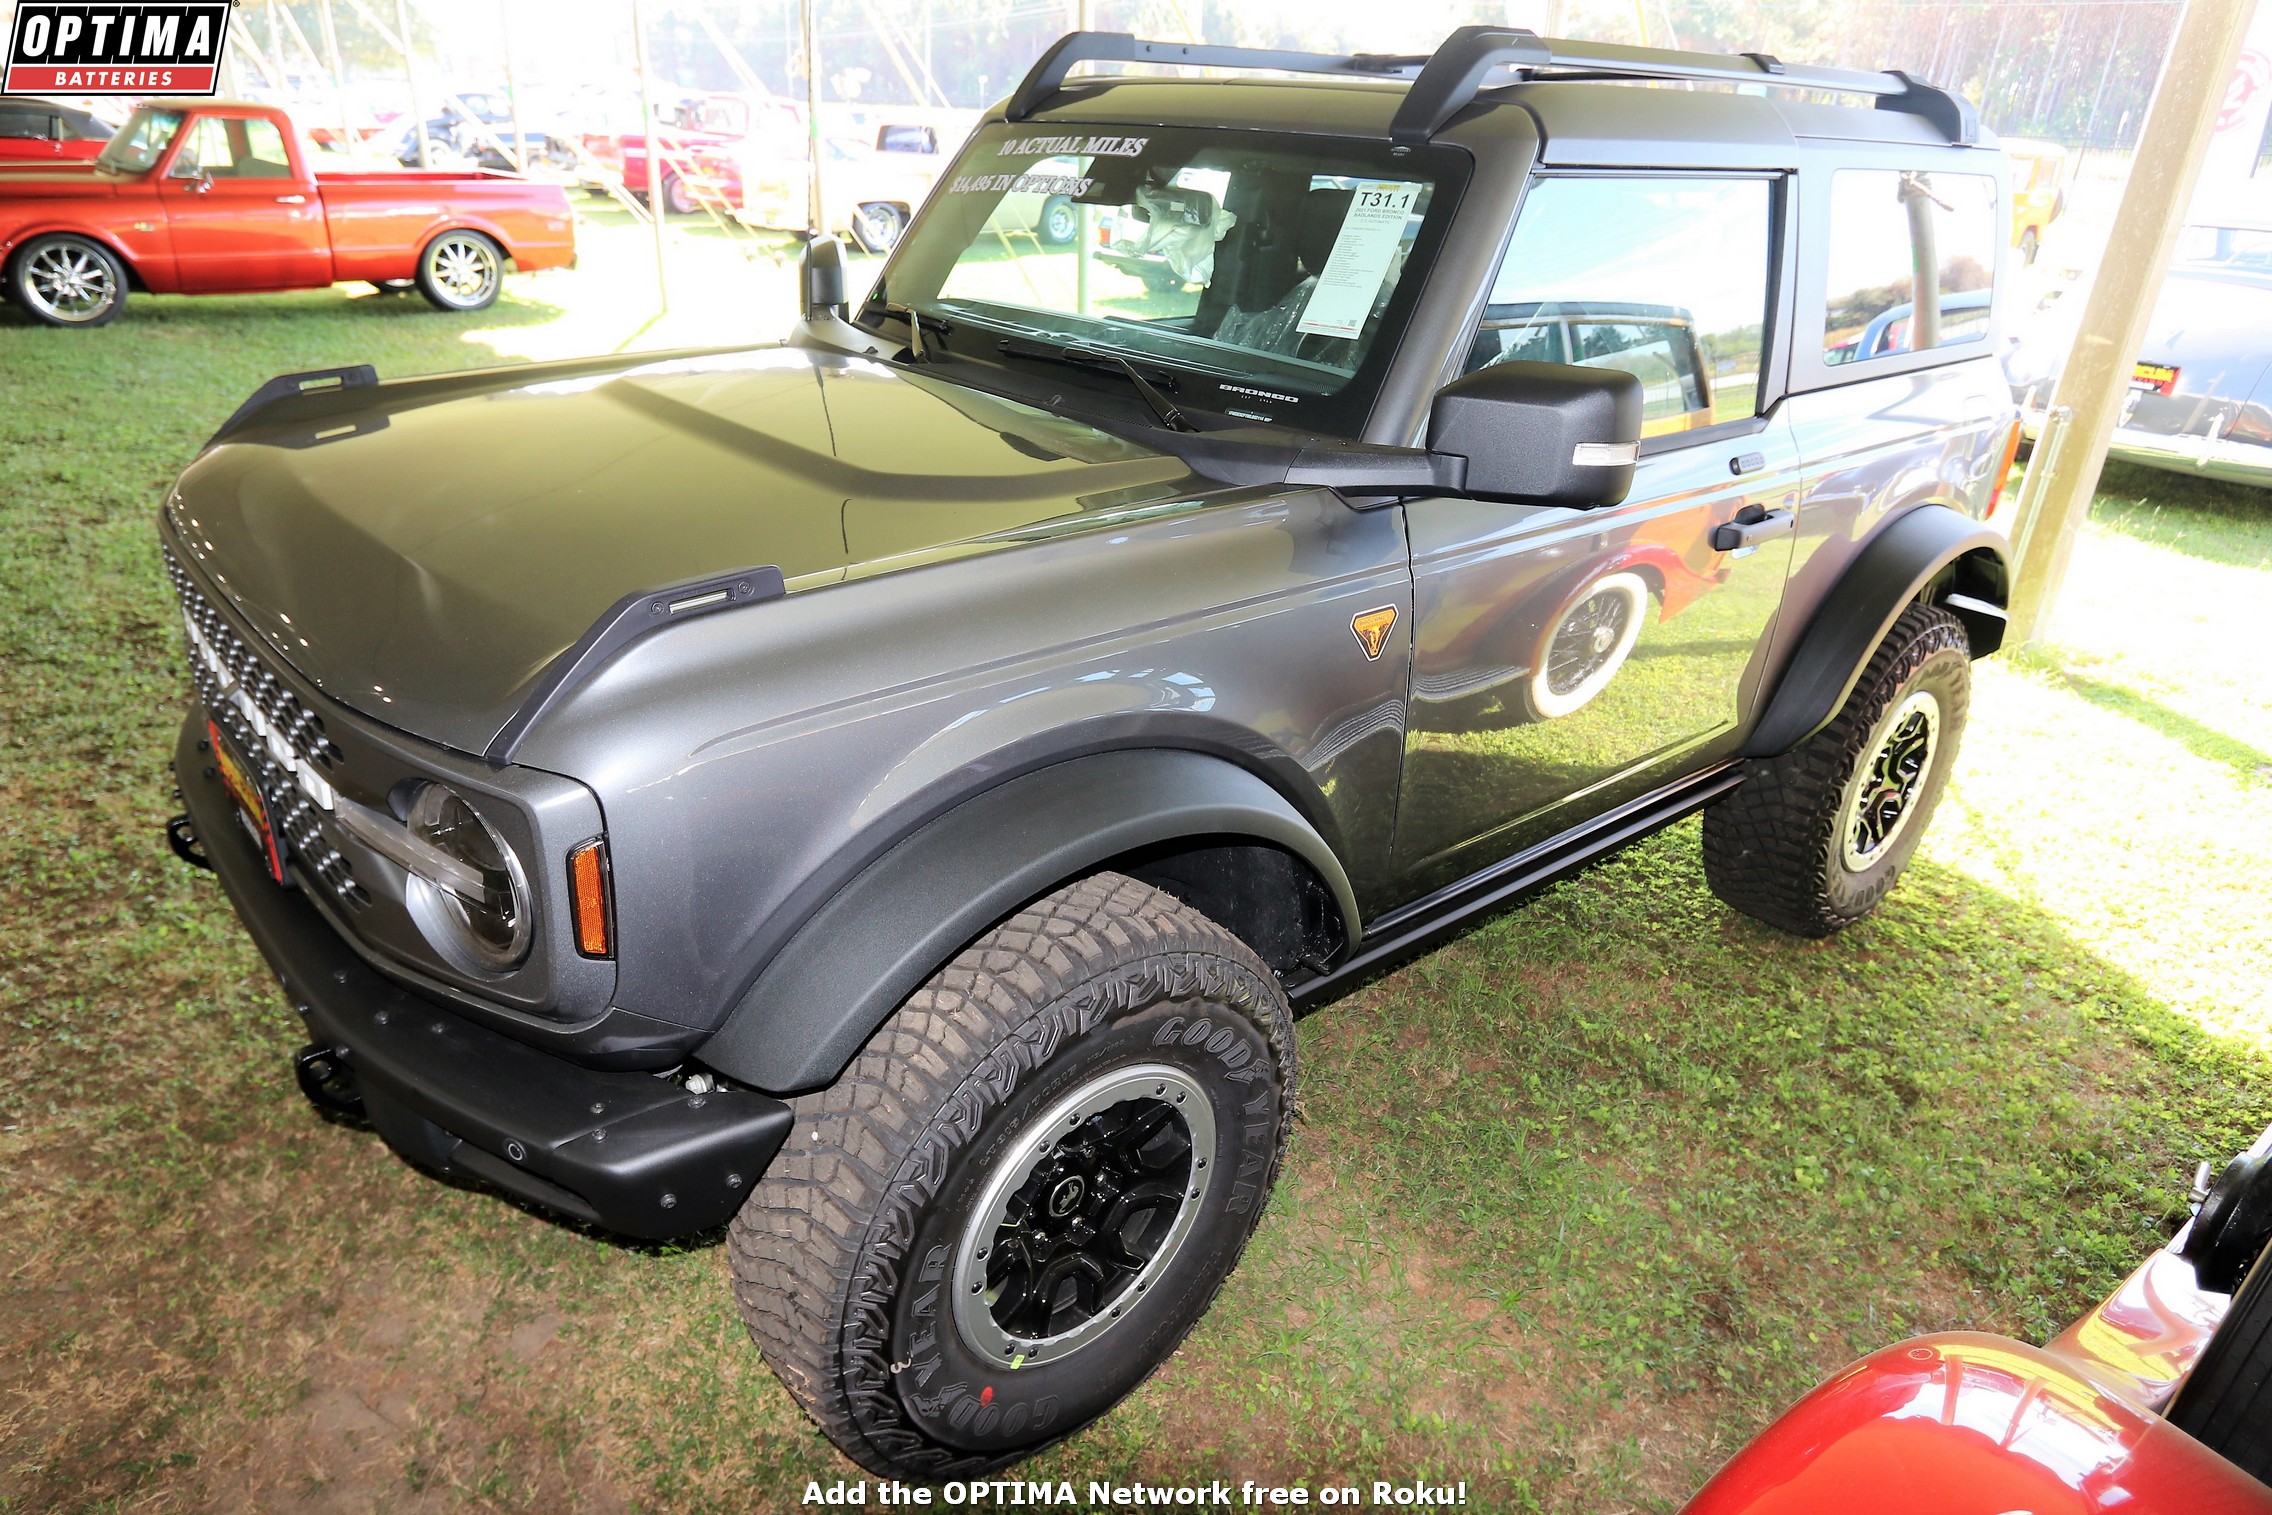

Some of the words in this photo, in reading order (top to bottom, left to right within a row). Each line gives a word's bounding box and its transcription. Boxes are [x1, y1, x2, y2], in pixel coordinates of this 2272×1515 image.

[998, 139, 1014, 156] 10
[1013, 136, 1083, 156] ACTUAL
[1080, 136, 1150, 158] MILES
[990, 174, 1017, 191] IN
[1011, 174, 1094, 198] OPTIONS
[1361, 192, 1410, 208] T31.1
[1219, 383, 1299, 403] BRONCO
